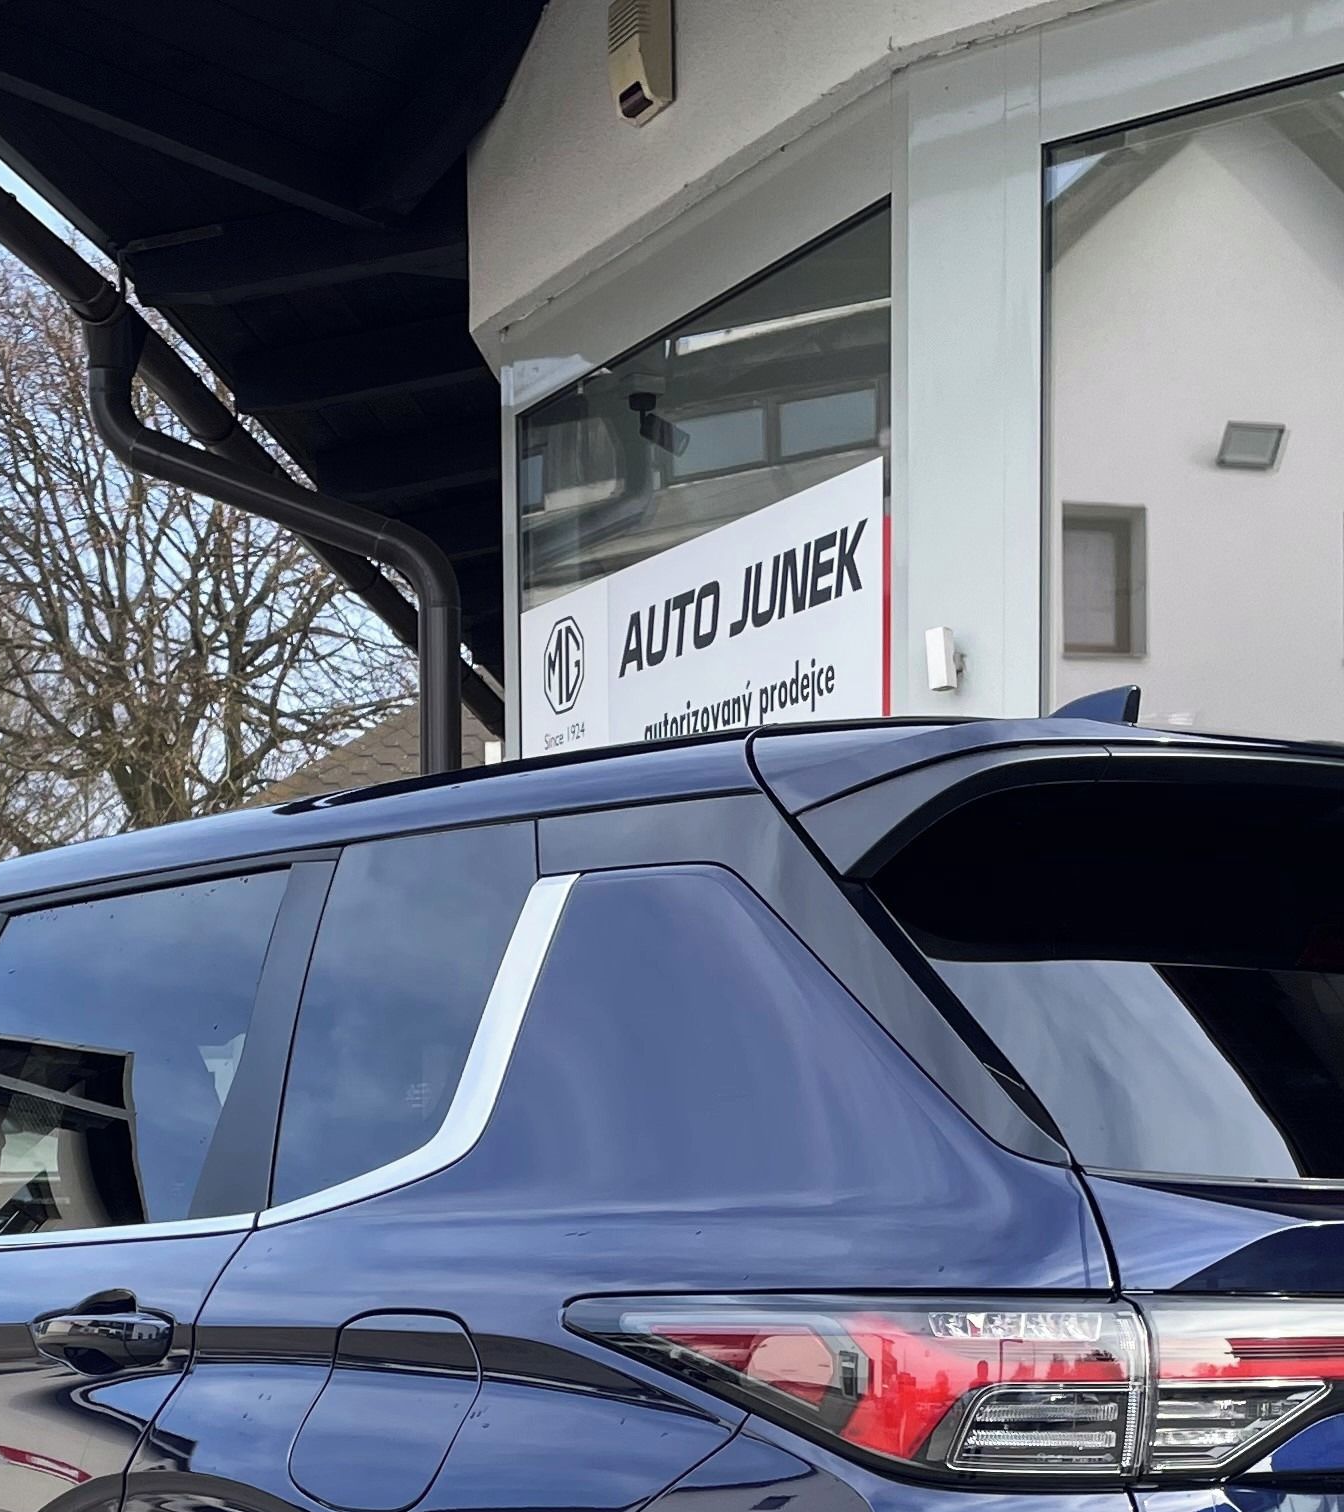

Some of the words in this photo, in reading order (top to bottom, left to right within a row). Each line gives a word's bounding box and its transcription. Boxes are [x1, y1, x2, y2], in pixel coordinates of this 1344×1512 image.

[619, 580, 720, 679] AUTO
[729, 518, 868, 638] JUNEK
[547, 625, 580, 705] MG
[644, 680, 753, 741] autorizovaný
[759, 658, 835, 724] prodejce
[544, 733, 564, 750] Since
[566, 721, 586, 742] 1924
